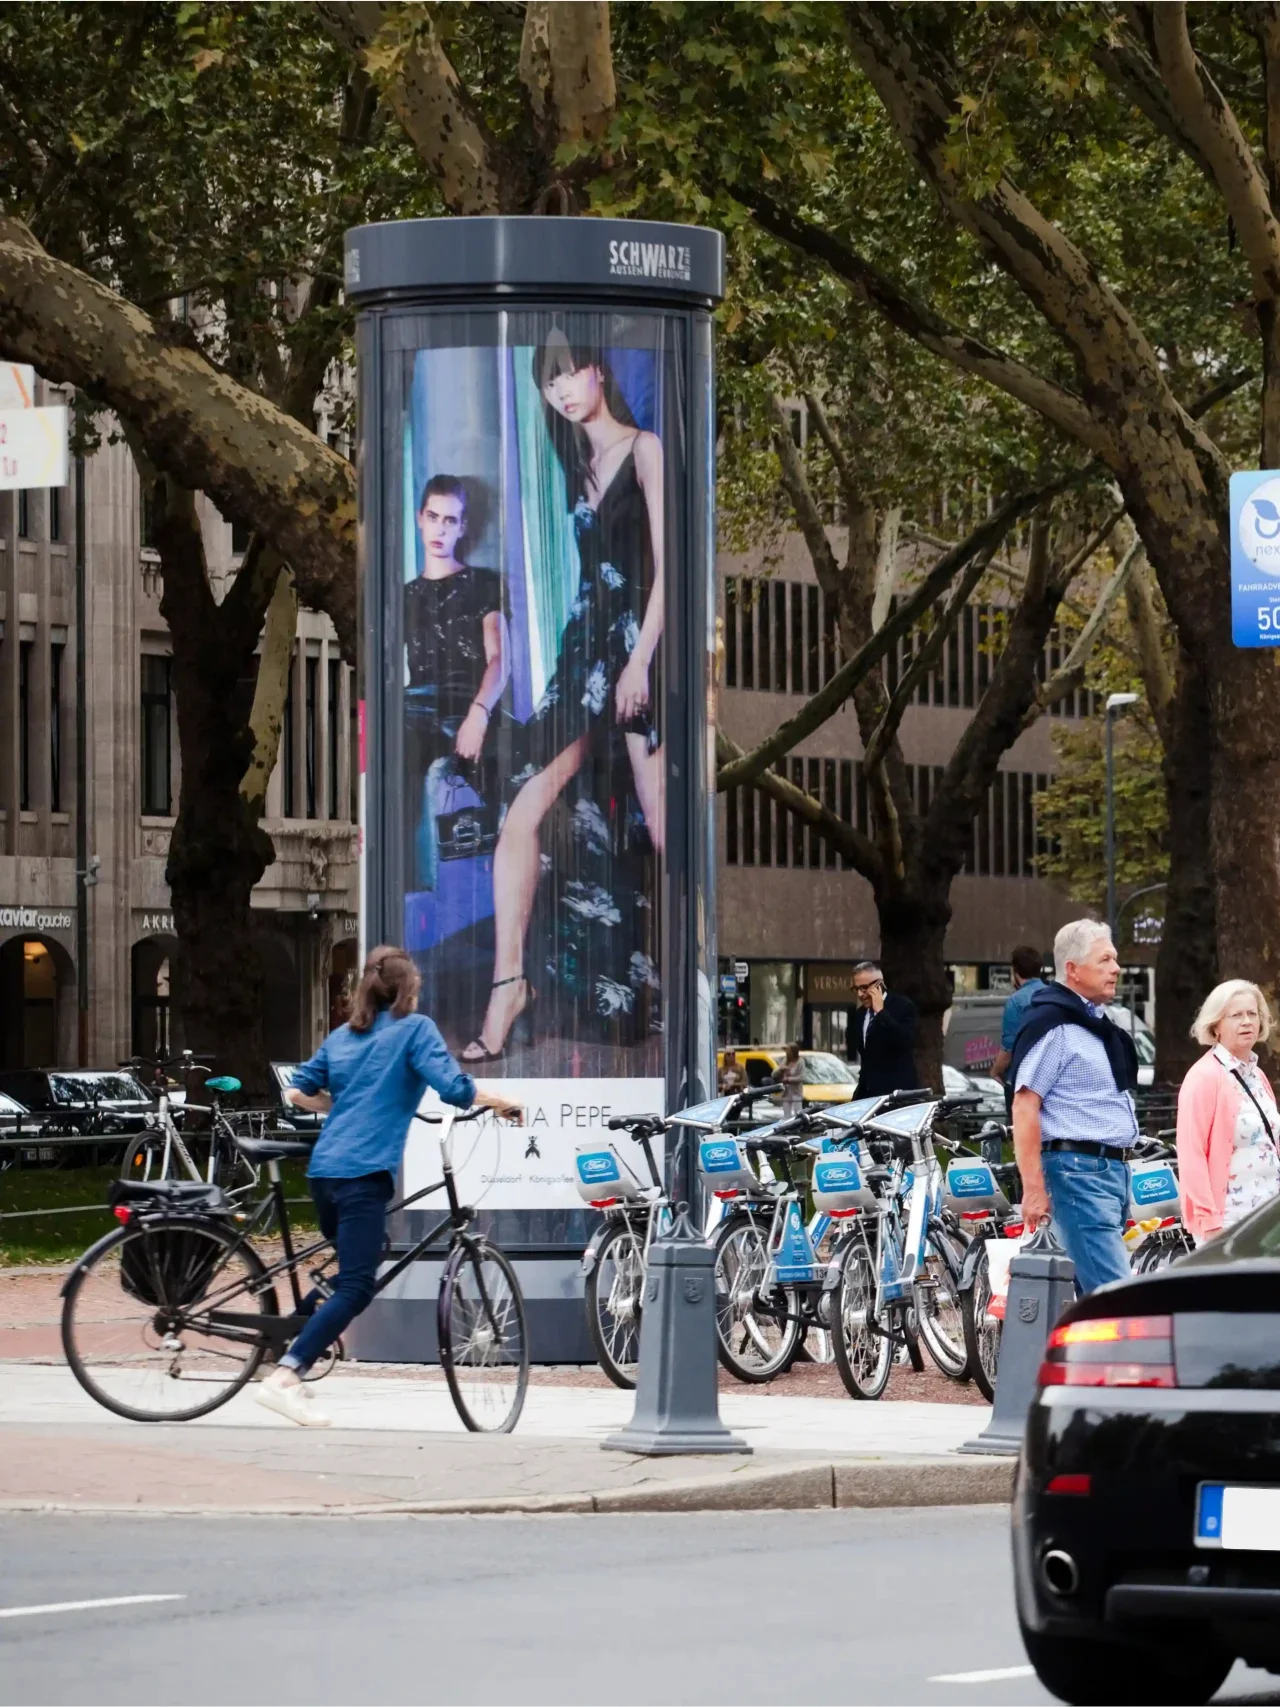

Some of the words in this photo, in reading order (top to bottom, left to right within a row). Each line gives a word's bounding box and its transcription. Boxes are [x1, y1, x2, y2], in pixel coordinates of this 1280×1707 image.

[609, 239, 685, 277] SCHWARZ
[38, 912, 71, 931] gauche
[143, 914, 174, 929] AKRI
[560, 1103, 612, 1127] PEPE
